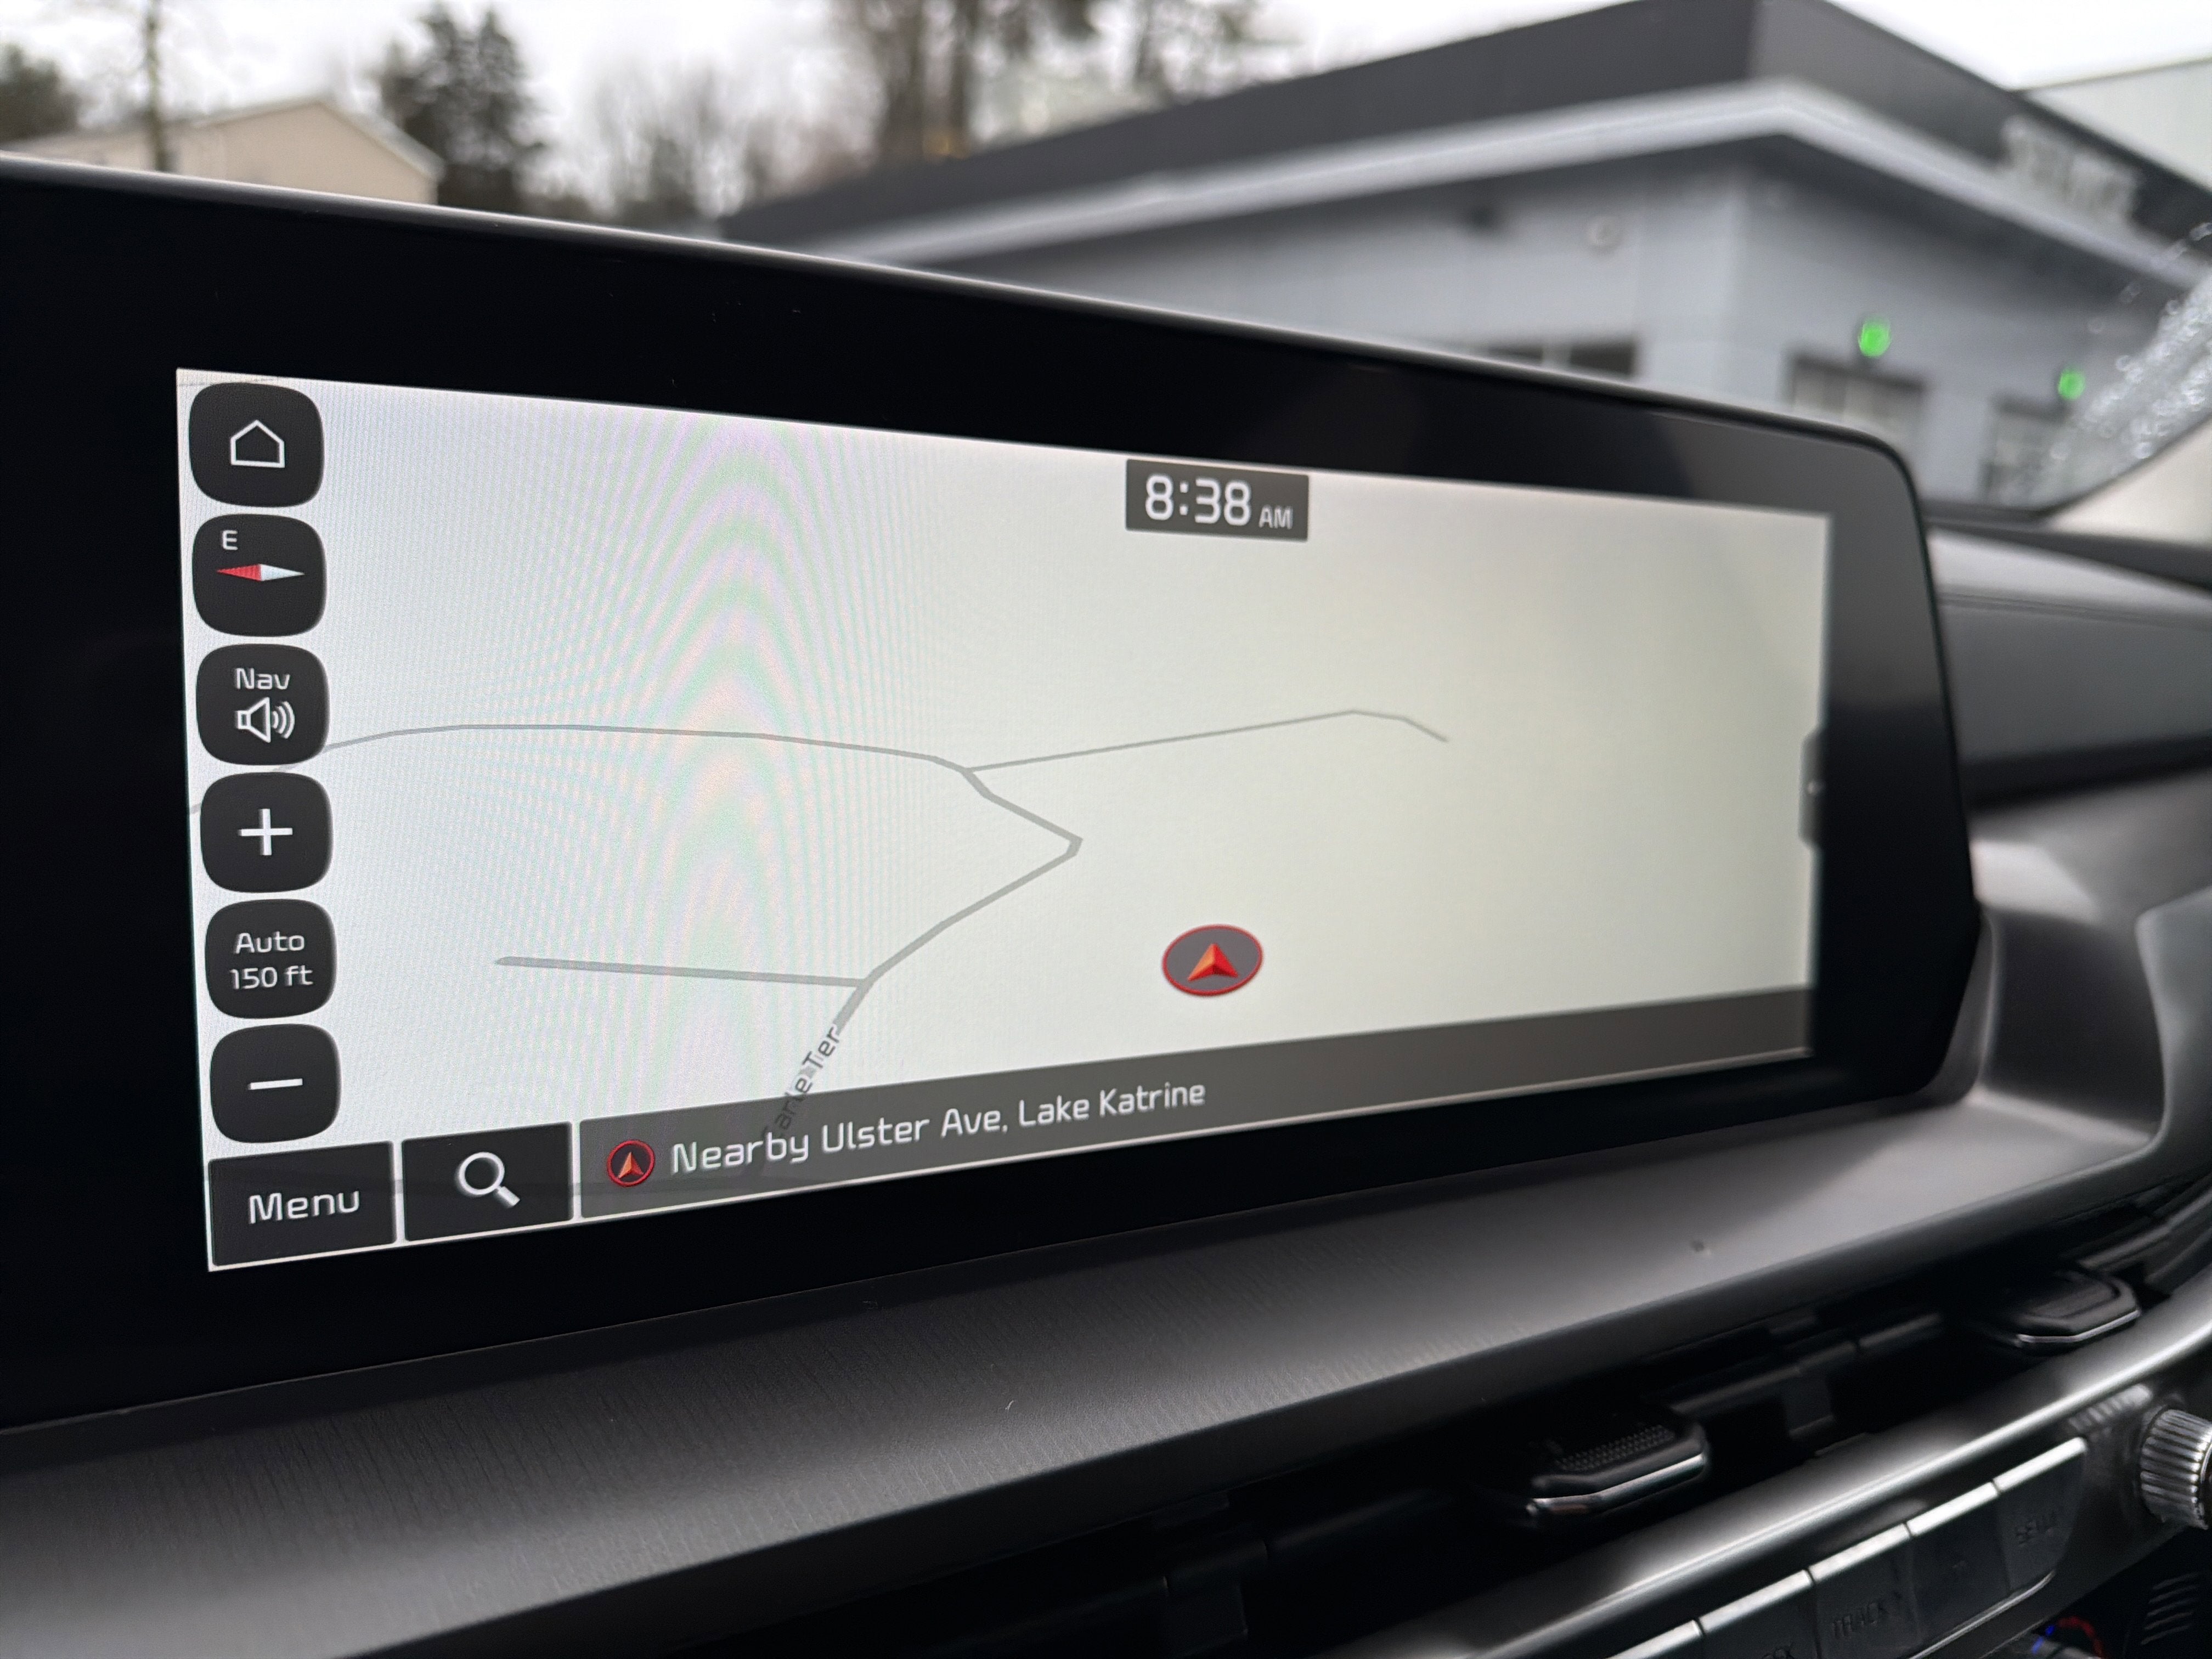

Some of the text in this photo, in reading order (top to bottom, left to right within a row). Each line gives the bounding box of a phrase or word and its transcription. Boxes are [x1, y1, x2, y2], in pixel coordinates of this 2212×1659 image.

[1145, 473, 1294, 529] 8:38 AM
[221, 530, 238, 551] E
[234, 667, 290, 690] Nav
[234, 931, 306, 954] Auto
[229, 964, 313, 990] 150 ft
[801, 1026, 840, 1070] Ter
[670, 1132, 809, 1176] Nearby
[822, 1118, 930, 1154] Ulster
[1018, 1095, 1090, 1127] Lake
[1098, 1081, 1206, 1117] Katrine
[248, 1190, 360, 1224] Menu
